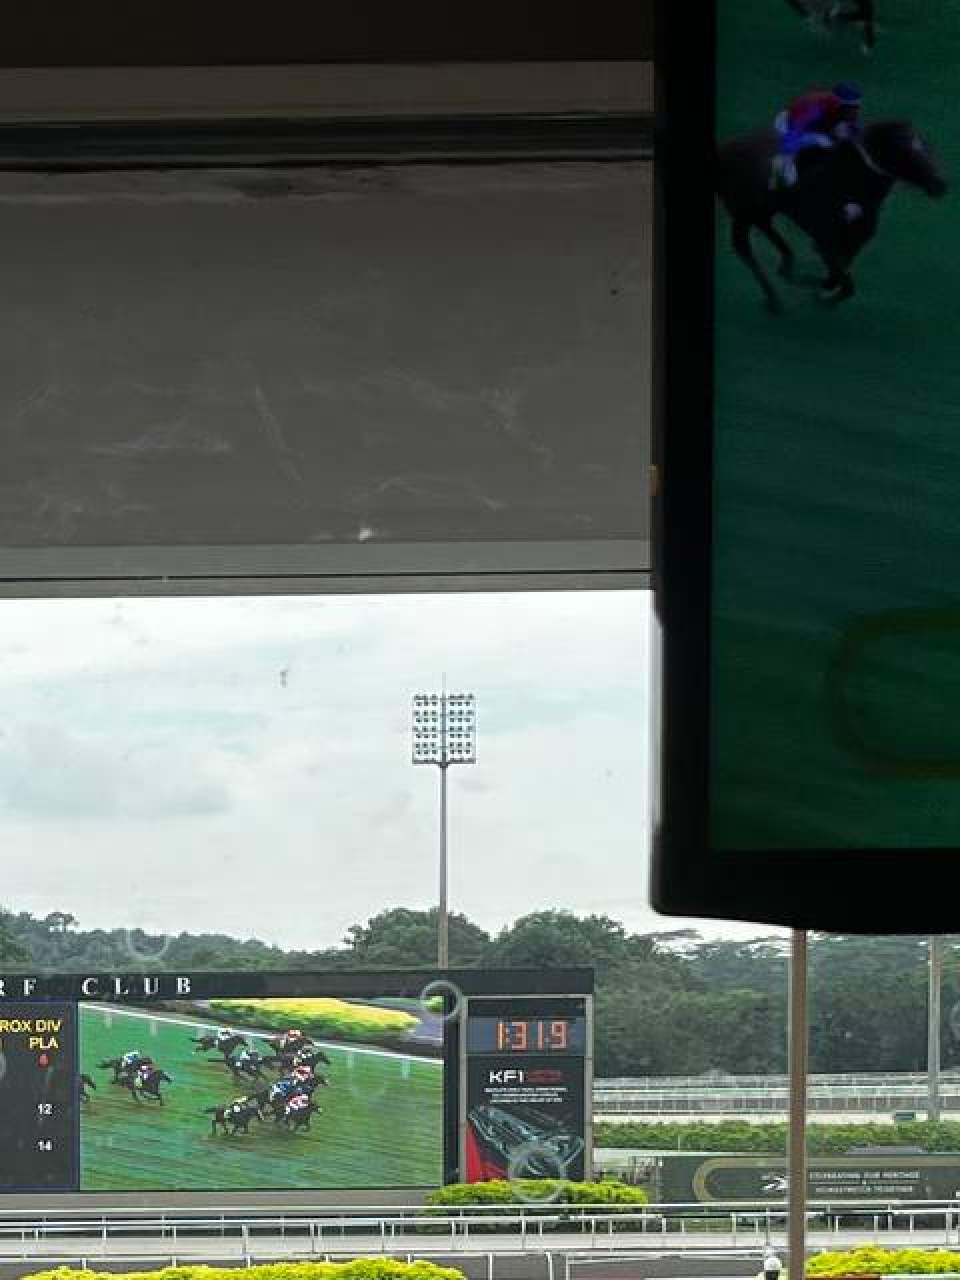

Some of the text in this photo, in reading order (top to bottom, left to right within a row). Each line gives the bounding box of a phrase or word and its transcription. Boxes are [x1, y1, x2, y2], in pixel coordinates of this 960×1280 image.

[81, 978, 191, 995] CLUB
[35, 1020, 62, 1032] DIV
[29, 1037, 59, 1049] PLA
